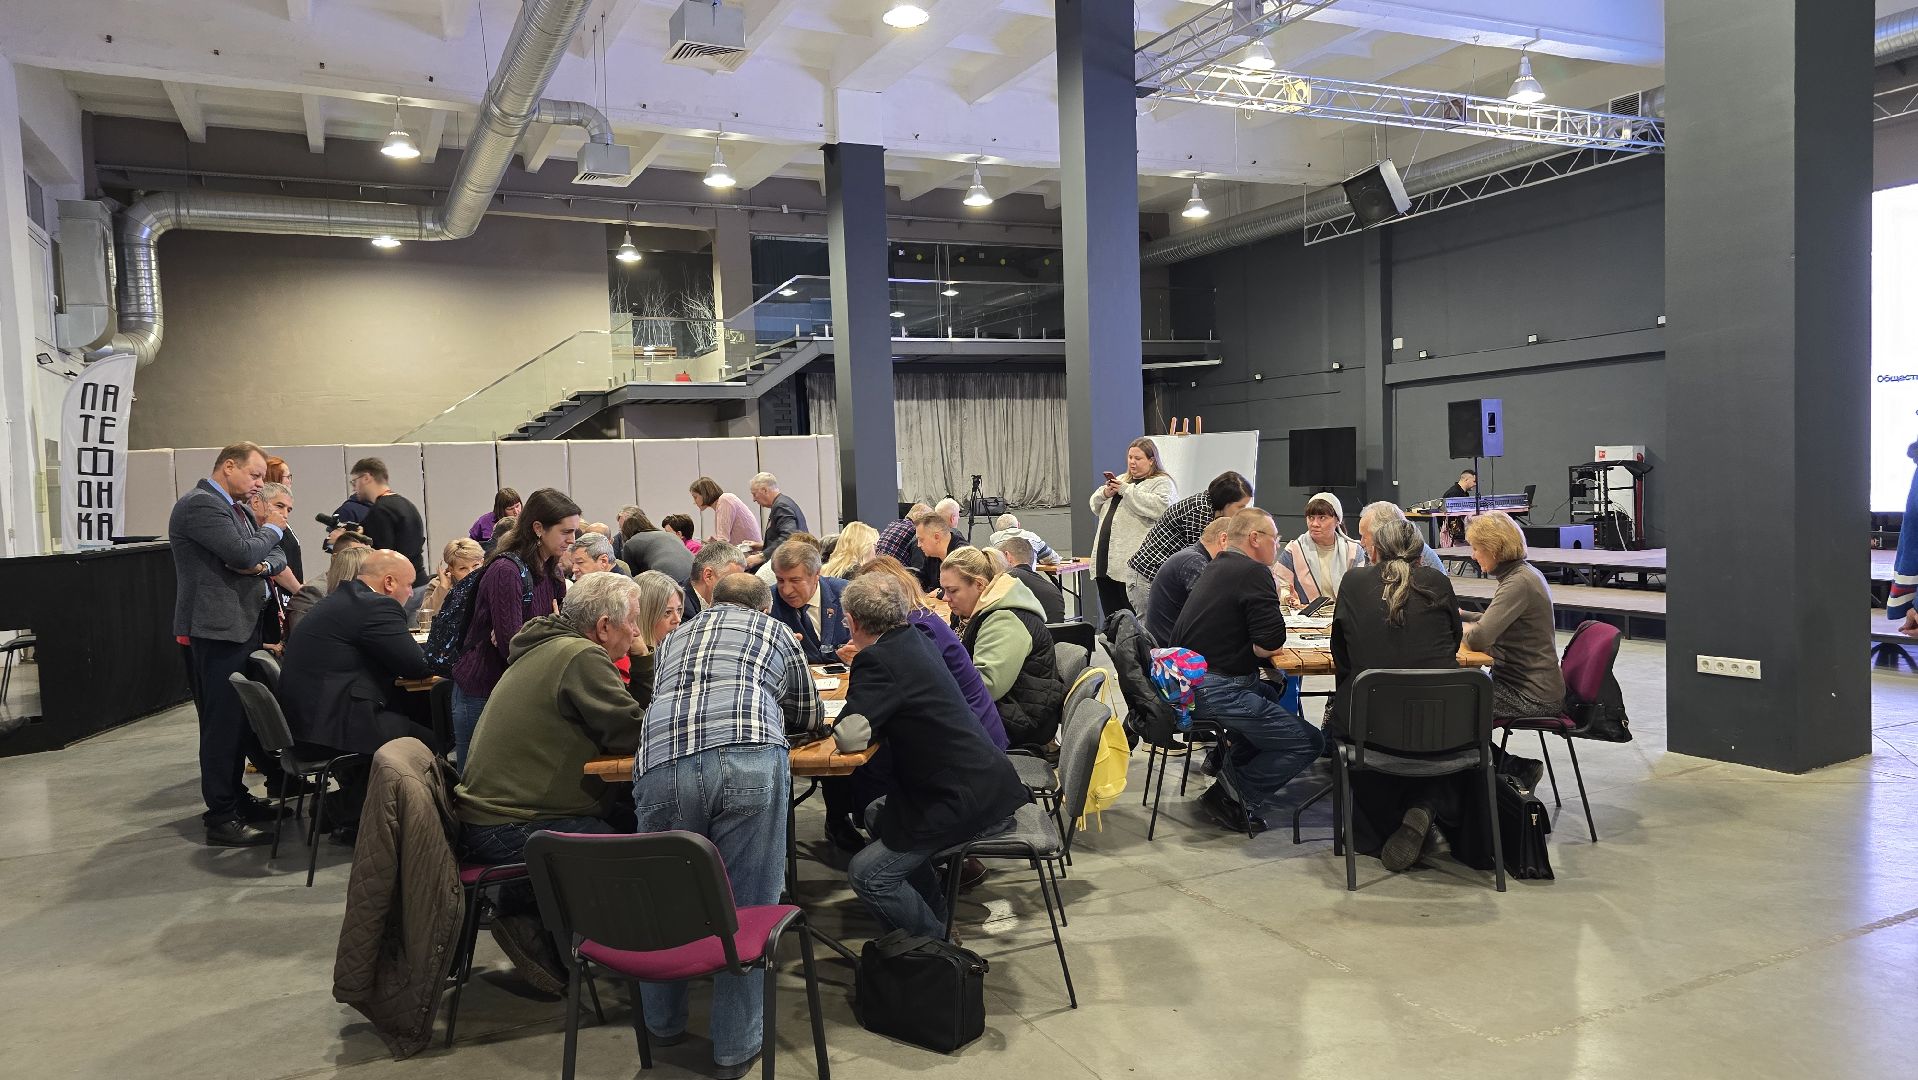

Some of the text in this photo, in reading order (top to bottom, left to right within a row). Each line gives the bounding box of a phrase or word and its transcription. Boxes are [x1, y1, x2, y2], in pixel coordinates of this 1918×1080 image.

[80, 382, 120, 413] ПА
[79, 414, 117, 445] ТЕ
[77, 446, 114, 476] Ф
[77, 480, 113, 509] ОН
[77, 512, 114, 541] КА
